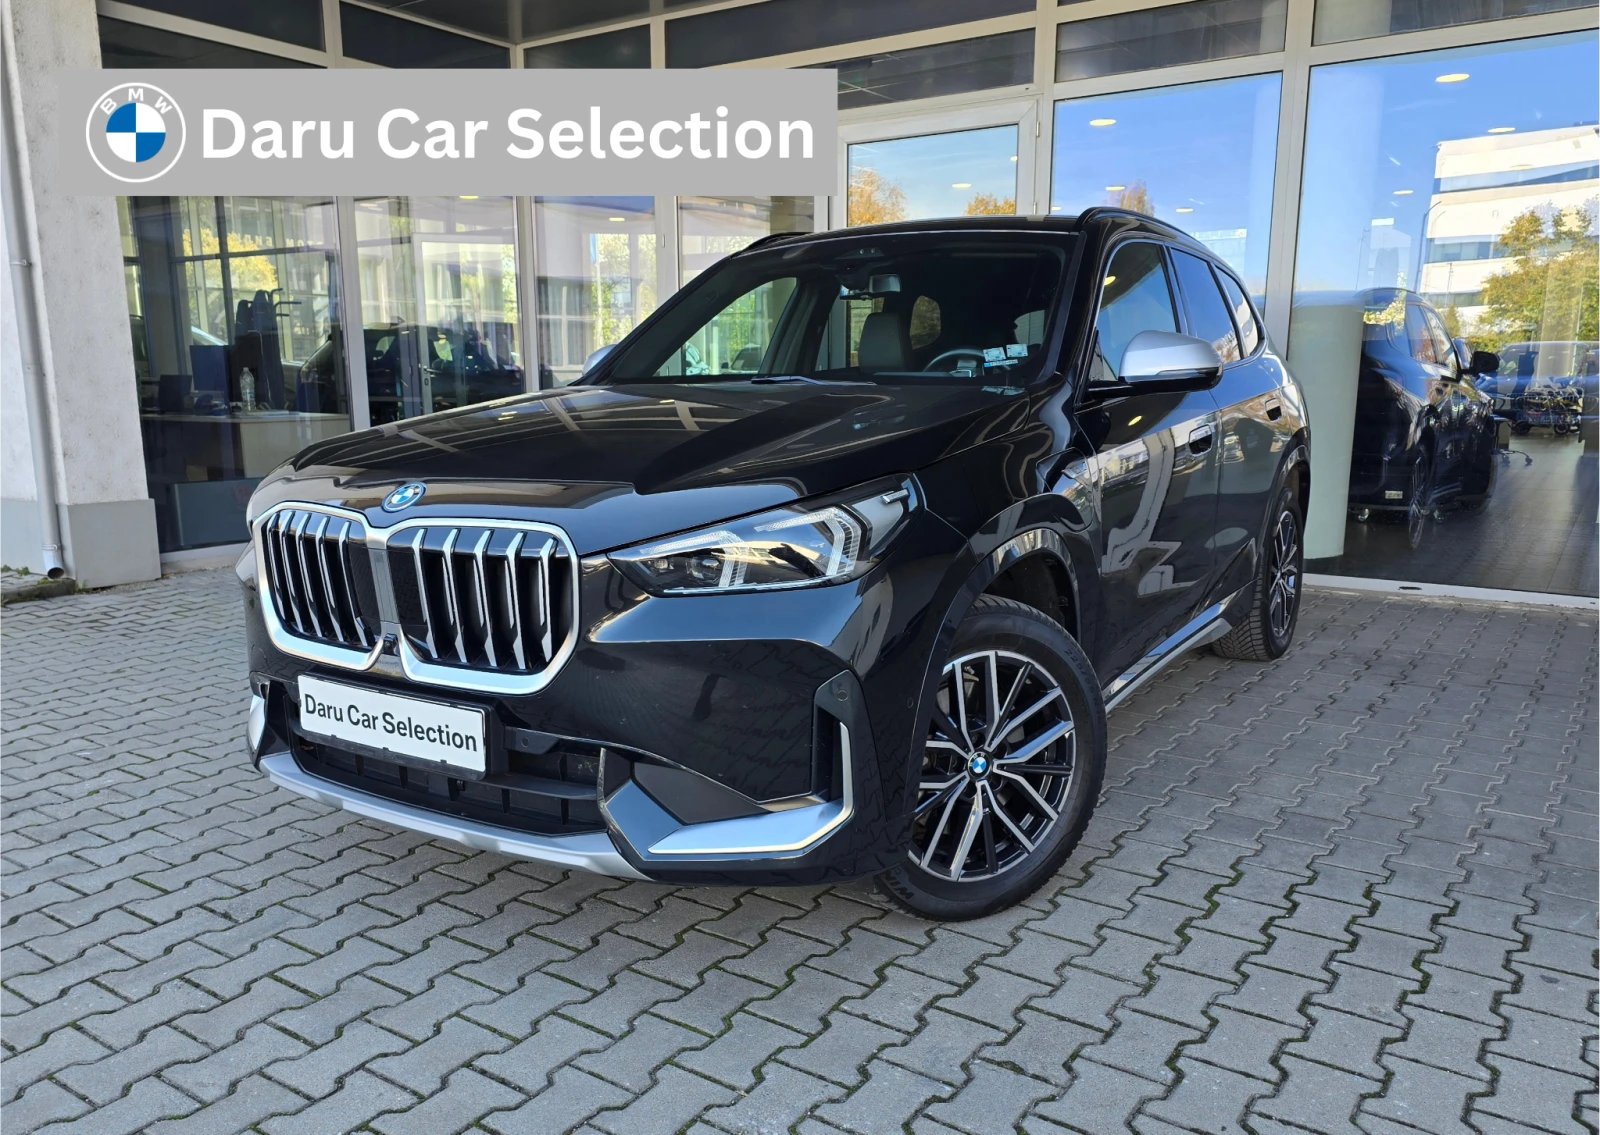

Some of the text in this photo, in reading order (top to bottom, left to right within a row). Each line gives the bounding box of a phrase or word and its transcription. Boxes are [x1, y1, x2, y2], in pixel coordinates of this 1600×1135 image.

[304, 693, 477, 752] Daru Car Selection
